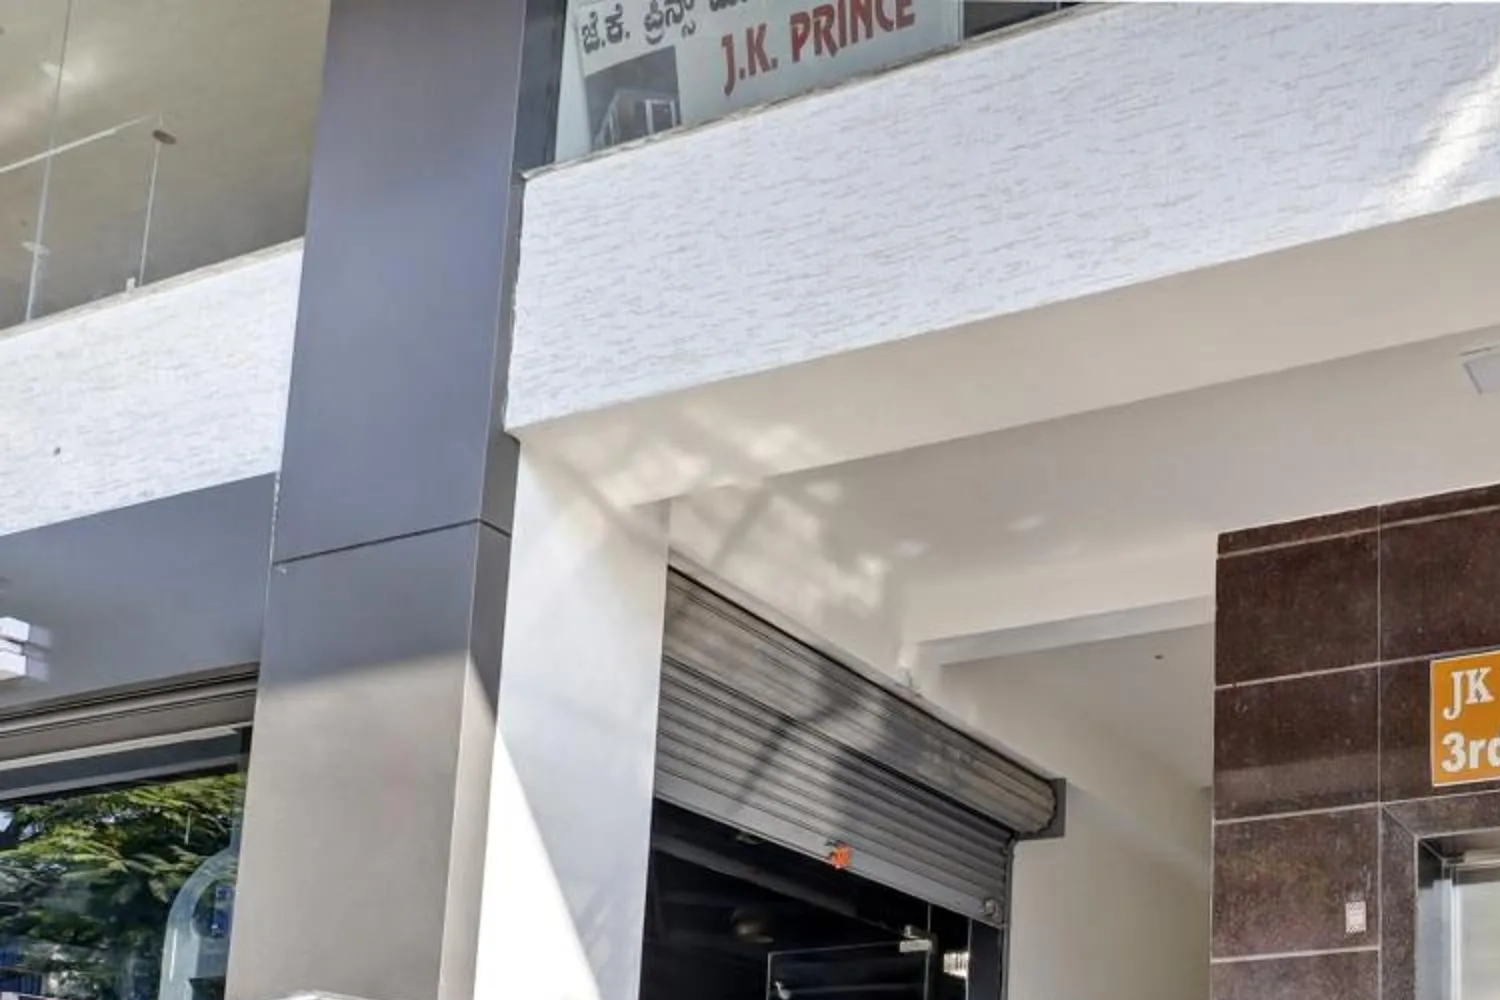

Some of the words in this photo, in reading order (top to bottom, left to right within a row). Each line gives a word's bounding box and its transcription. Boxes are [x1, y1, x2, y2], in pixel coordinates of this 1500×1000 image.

[721, 23, 779, 96] J.K.
[789, 0, 916, 63] PRINCE
[1443, 667, 1495, 720] JK
